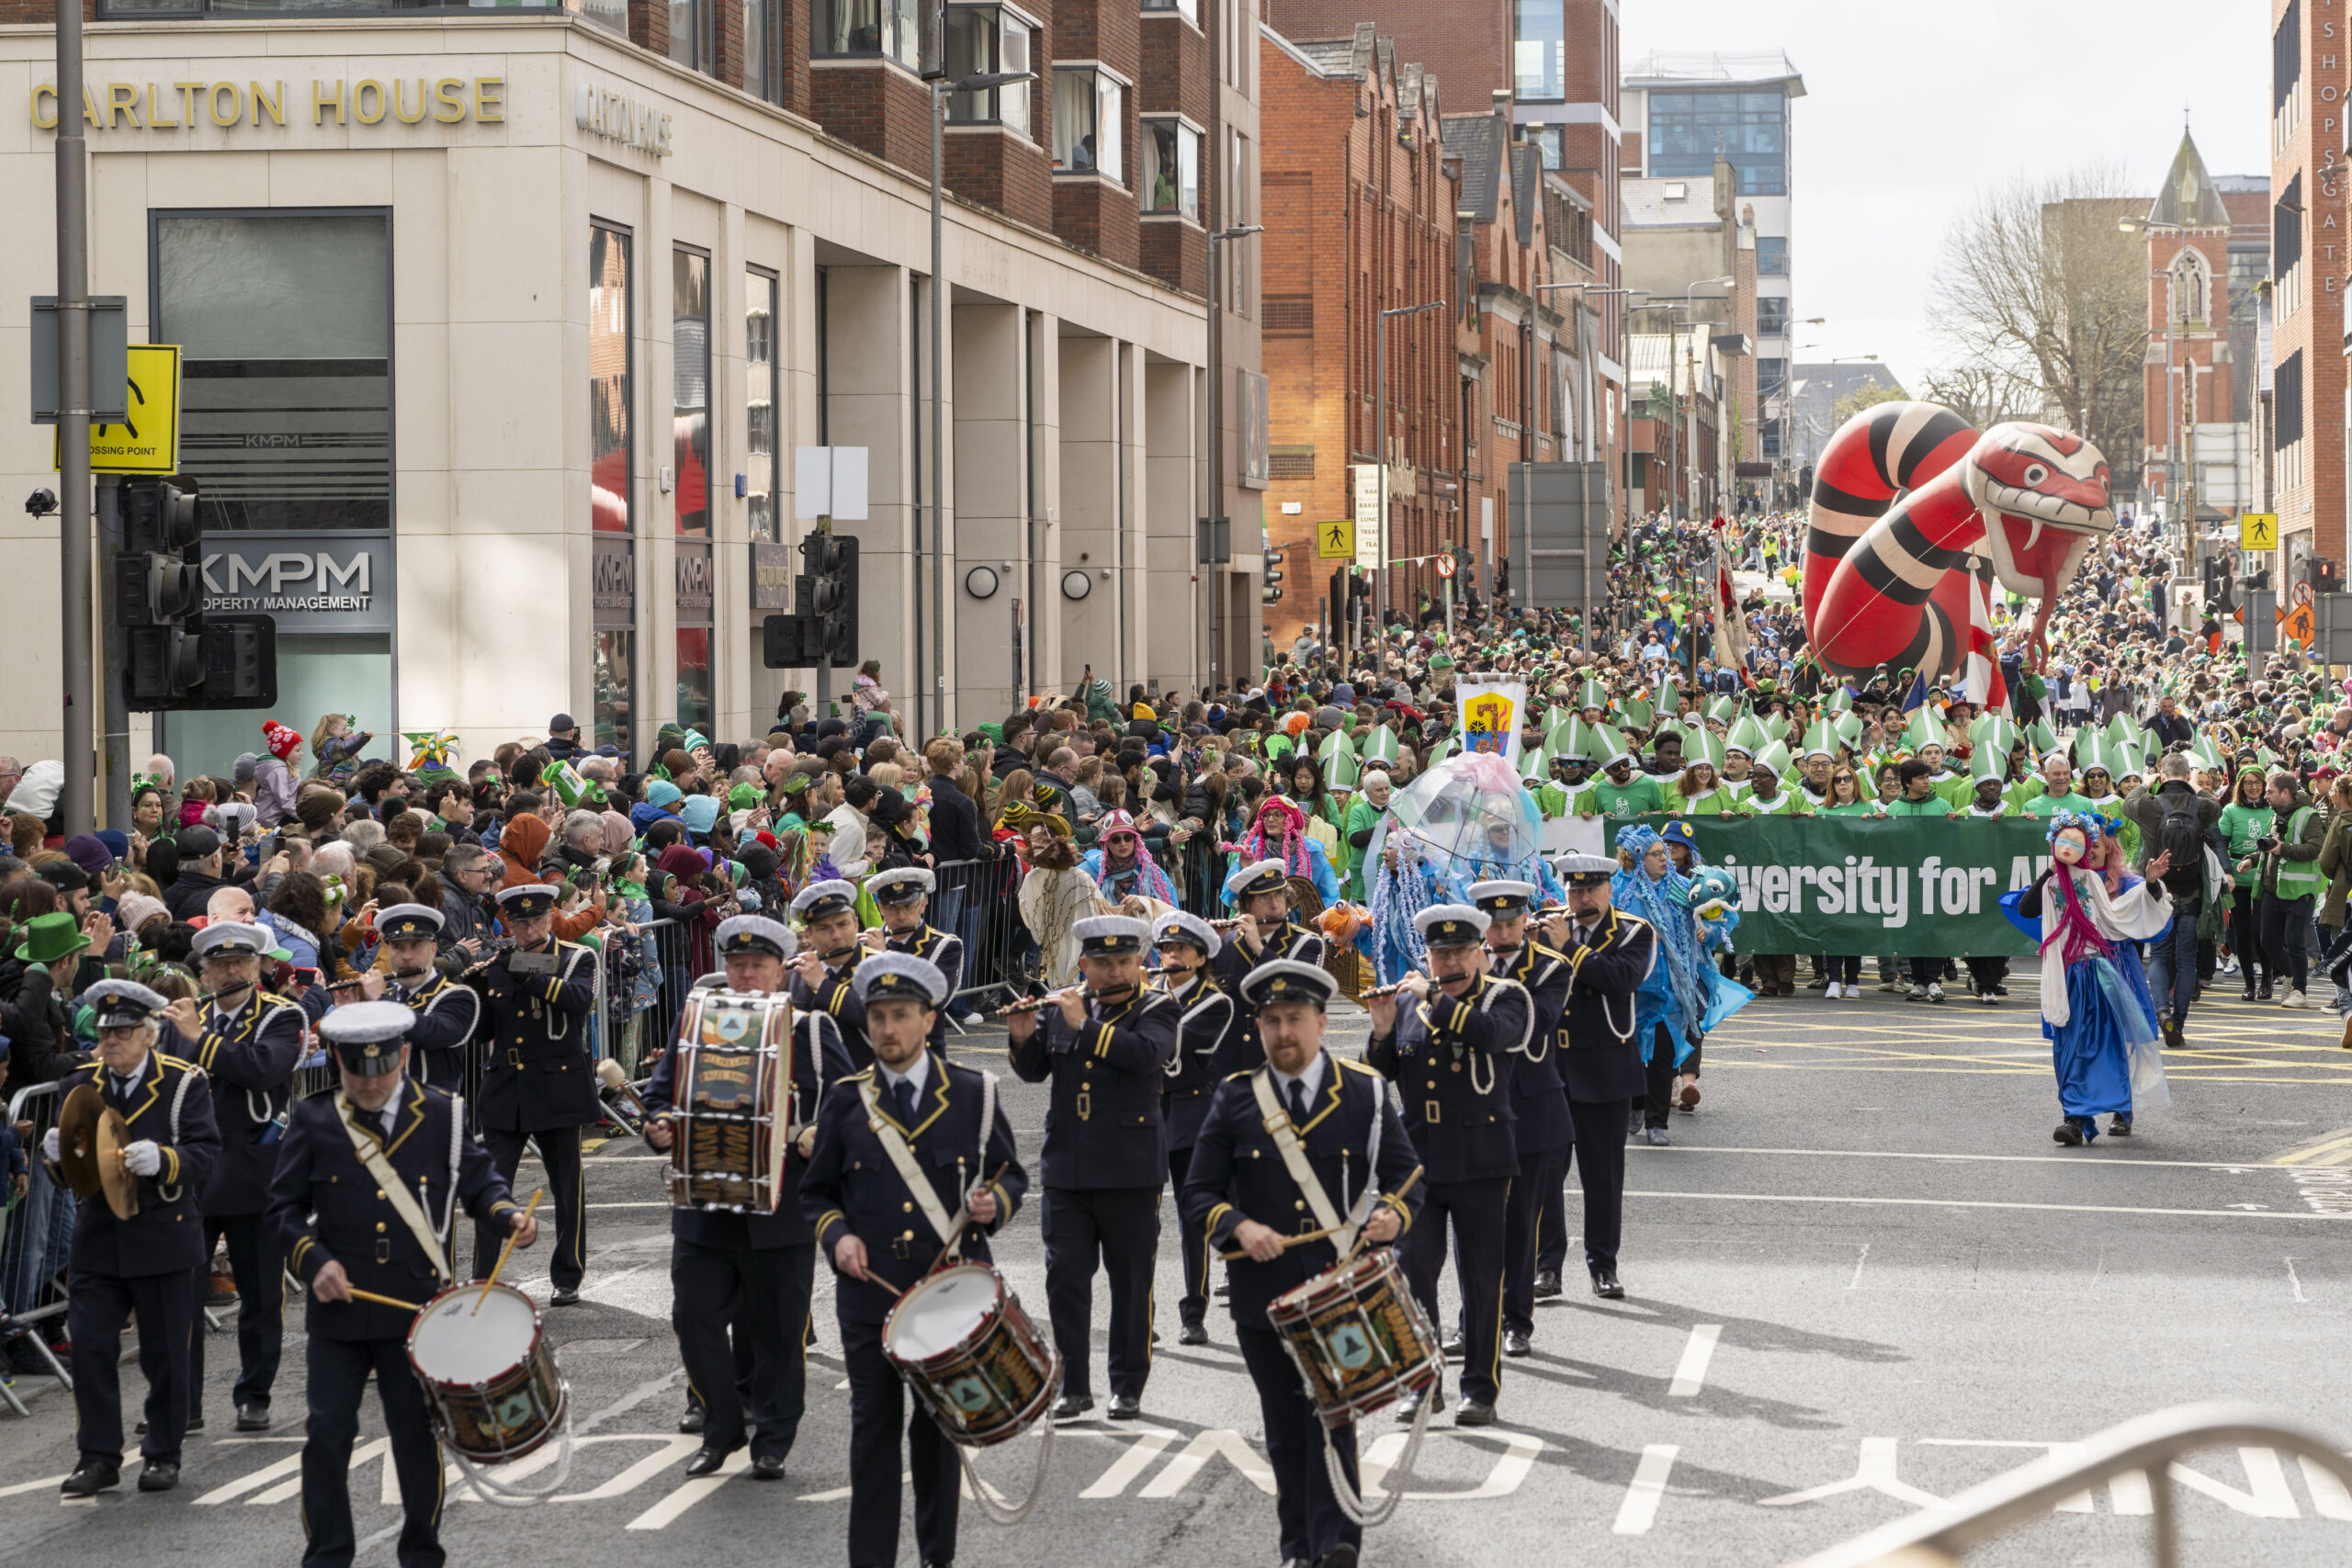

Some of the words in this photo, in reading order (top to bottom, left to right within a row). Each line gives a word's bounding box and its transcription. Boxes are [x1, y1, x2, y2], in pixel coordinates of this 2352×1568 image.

[312, 77, 504, 125] HOUSE
[89, 446, 124, 456] OSSING
[127, 446, 157, 456] POINT
[245, 434, 300, 447] KMPM
[201, 552, 369, 593] KMPM
[595, 554, 633, 592] KMPM
[680, 556, 712, 593] KMPM
[202, 596, 260, 610] OPERTY
[263, 596, 369, 609] MANAGEMENT
[1918, 855, 1996, 915] for
